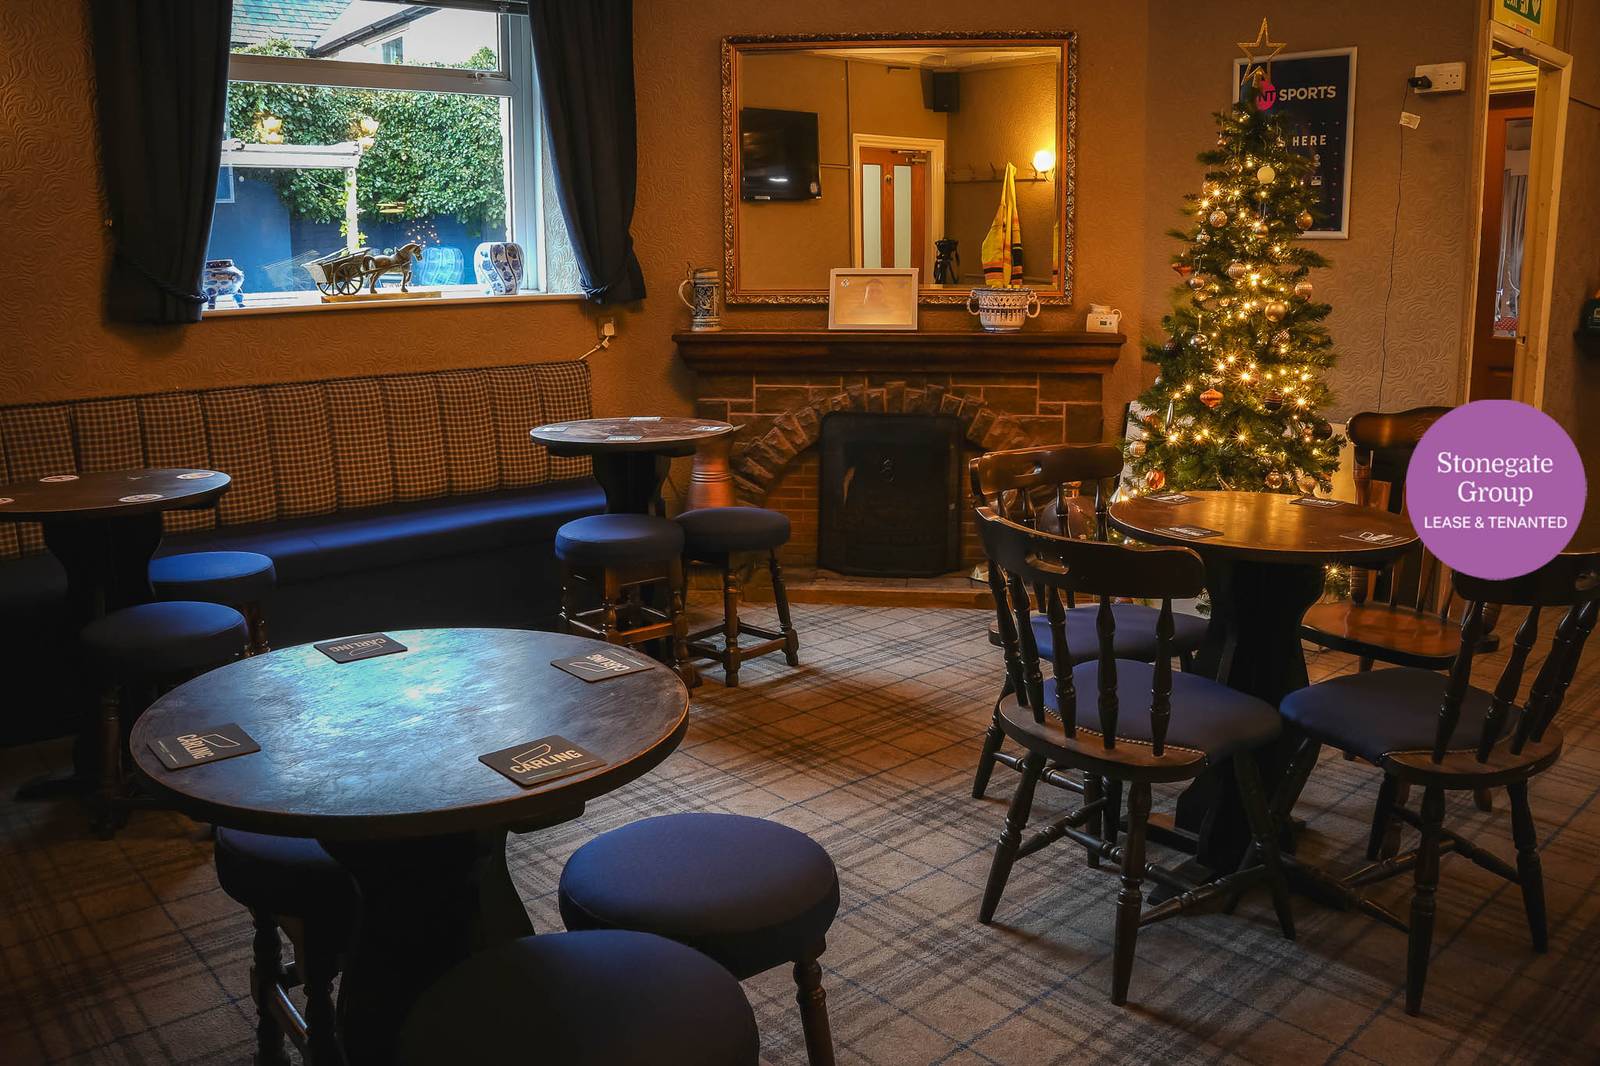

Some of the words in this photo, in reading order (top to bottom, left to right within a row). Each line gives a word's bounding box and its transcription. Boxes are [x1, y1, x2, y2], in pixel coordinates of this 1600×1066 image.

[1279, 86, 1336, 101] SPORTS
[1292, 135, 1327, 147] HERE
[328, 638, 386, 652] CARLING
[177, 734, 214, 759] CARLING
[510, 750, 583, 773] CARLING
